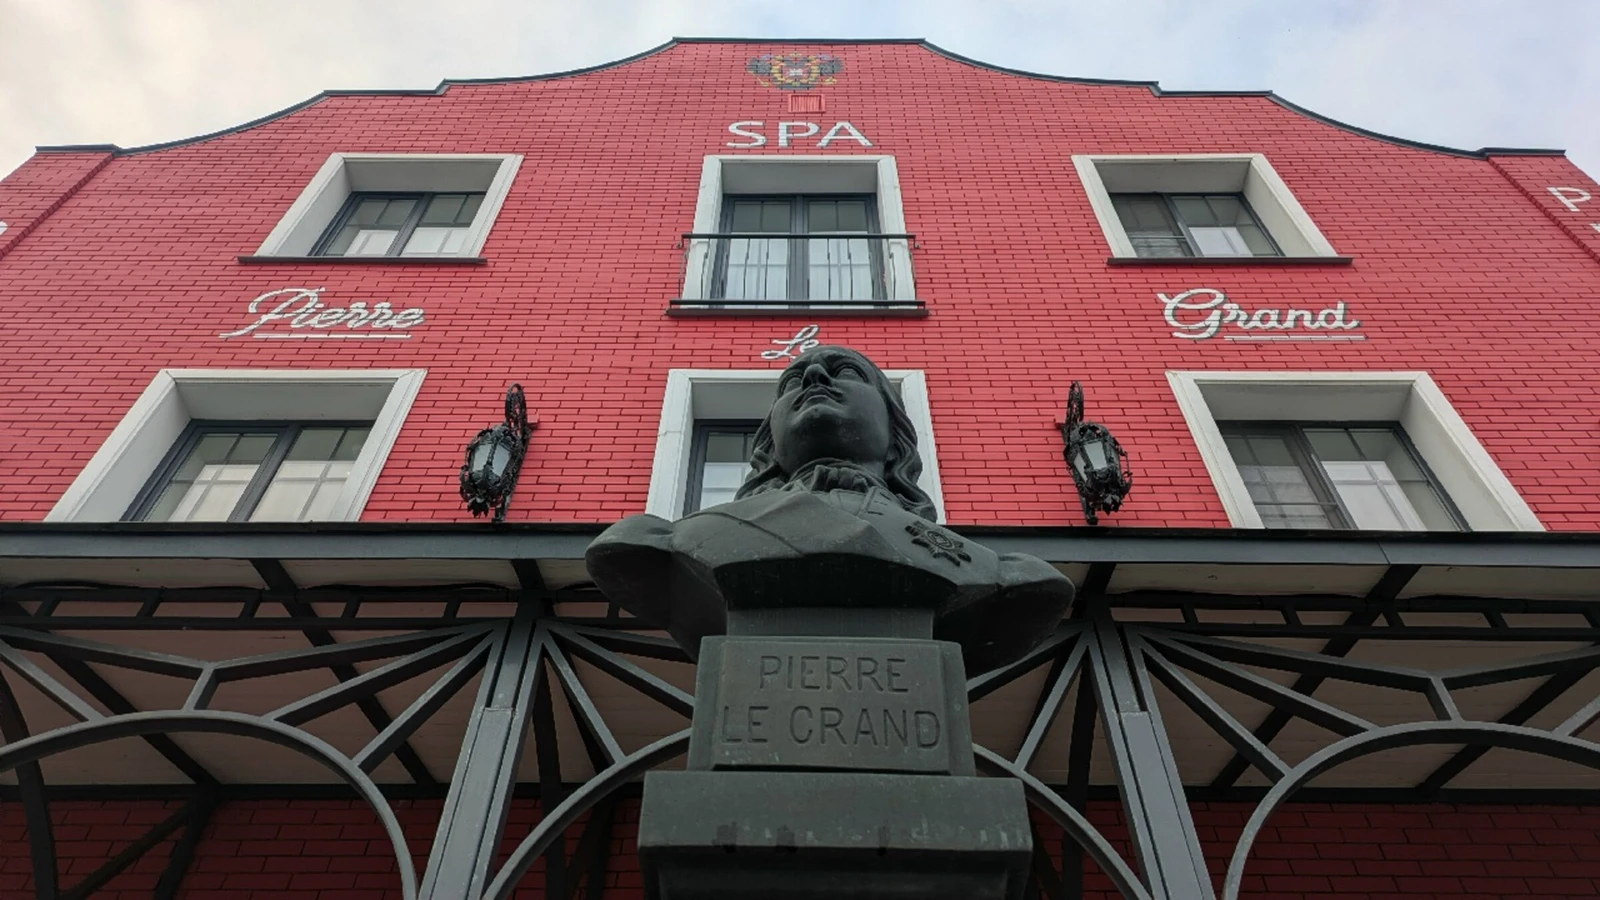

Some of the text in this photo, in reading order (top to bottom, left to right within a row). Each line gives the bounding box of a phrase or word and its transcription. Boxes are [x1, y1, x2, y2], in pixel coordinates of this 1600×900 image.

[726, 120, 873, 147] SPA
[219, 287, 424, 338] Pierre
[1157, 288, 1361, 339] Grand
[759, 655, 909, 693] PIERRE
[722, 704, 769, 743] LE
